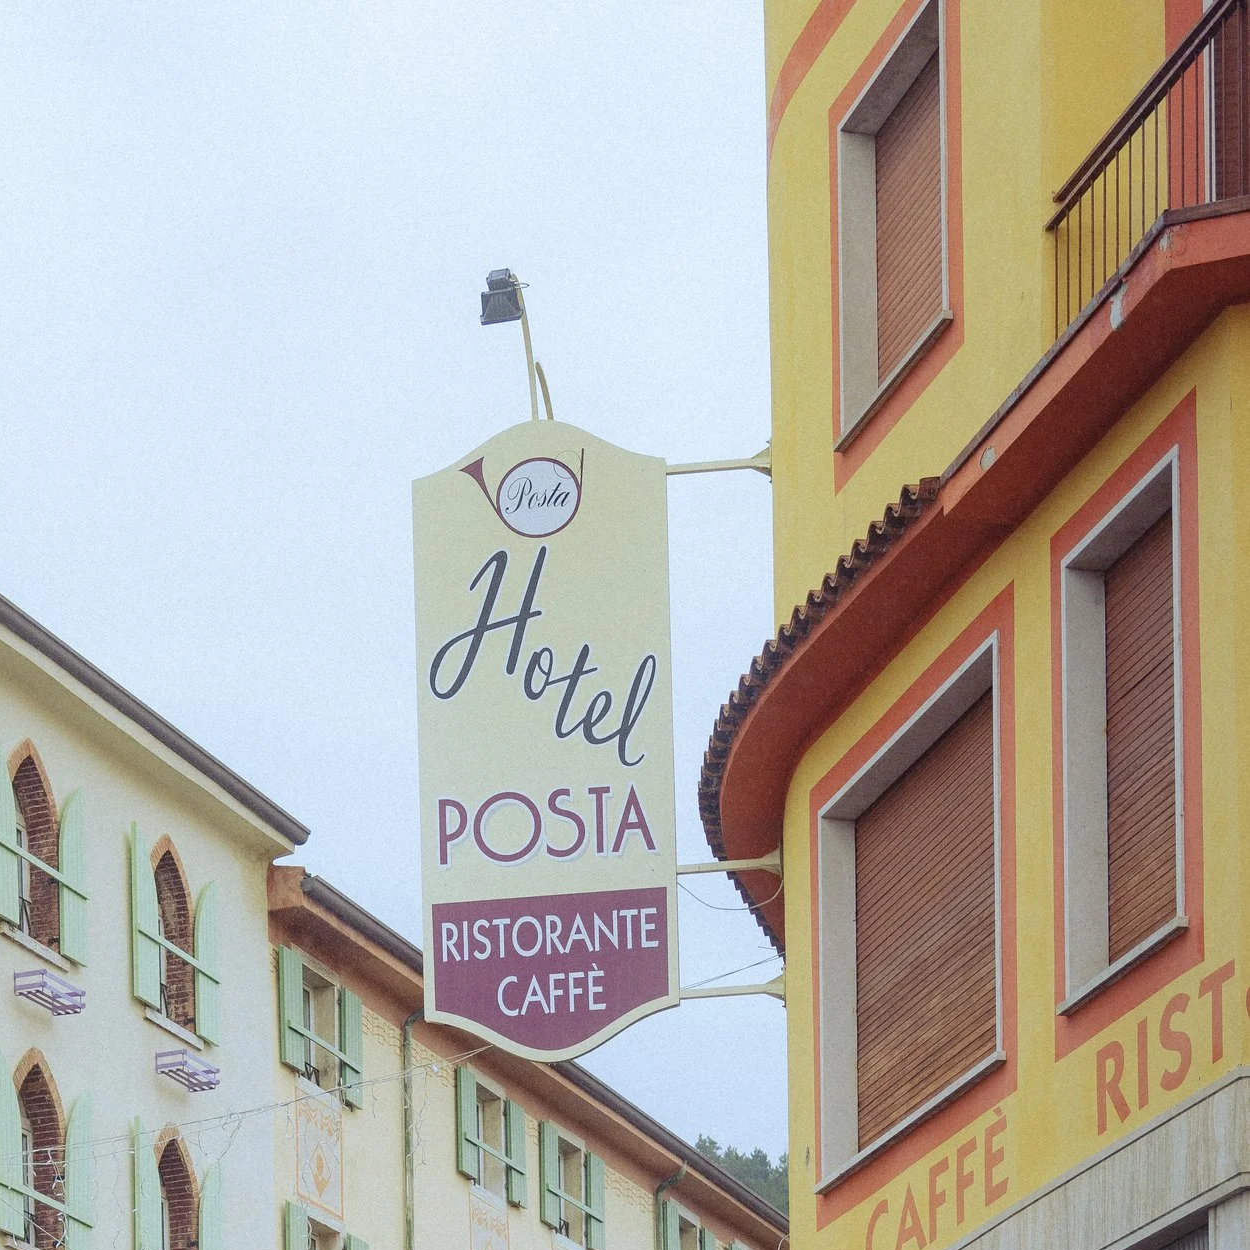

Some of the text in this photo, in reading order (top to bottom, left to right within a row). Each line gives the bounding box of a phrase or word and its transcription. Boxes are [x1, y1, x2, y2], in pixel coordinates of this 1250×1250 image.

[505, 476, 570, 514] Posta
[429, 545, 657, 767] Hotel
[438, 784, 656, 865] POSTA
[441, 907, 659, 962] RISTORANTE
[497, 963, 606, 1017] CAFFÈ
[1096, 958, 1250, 1137] RIST
